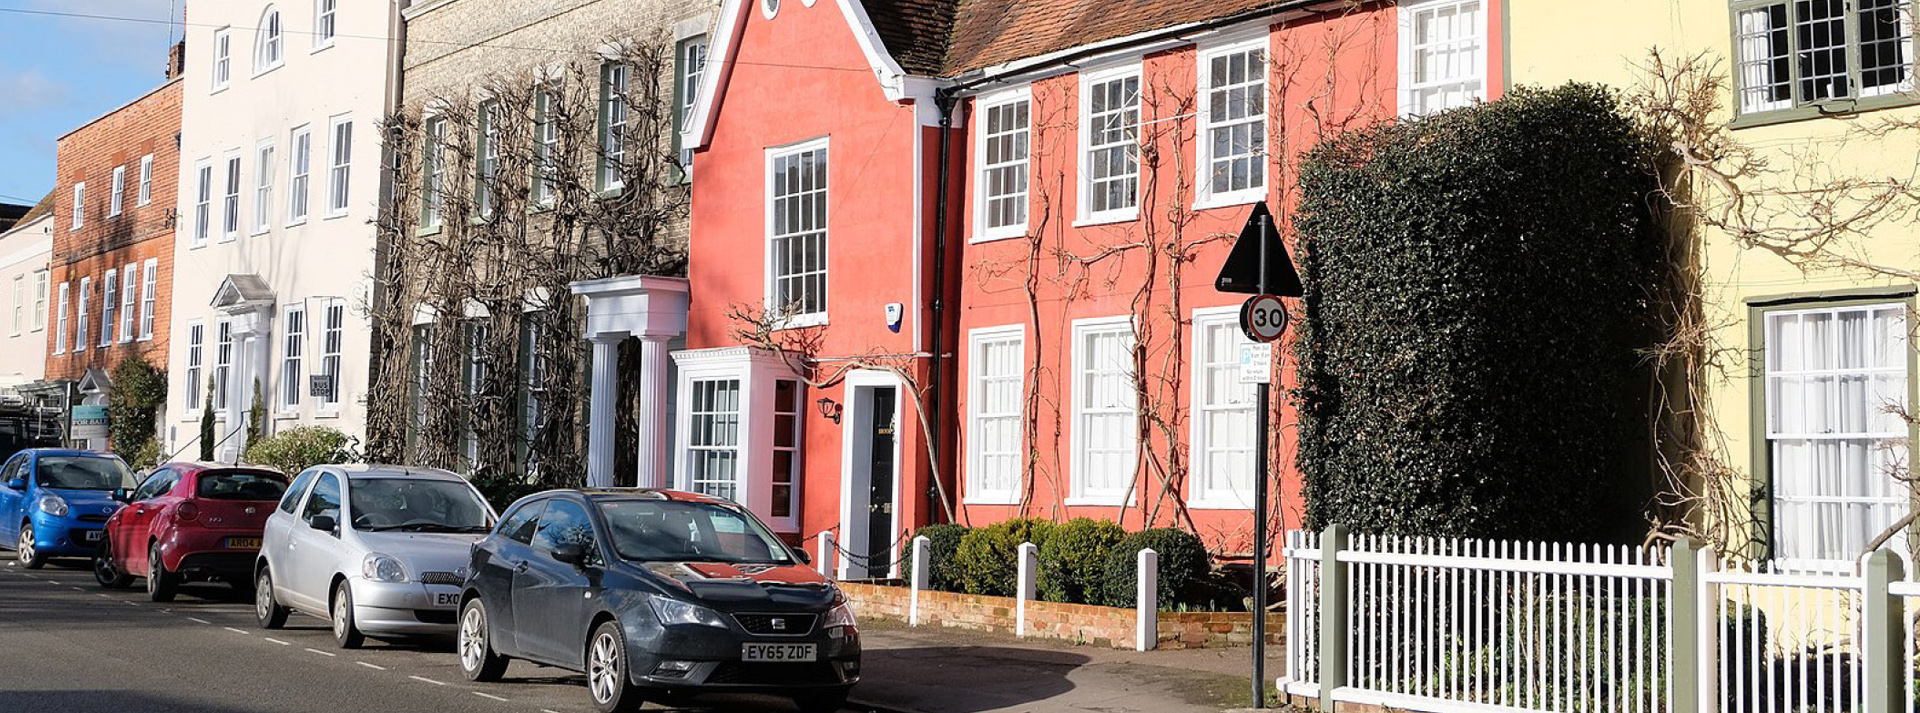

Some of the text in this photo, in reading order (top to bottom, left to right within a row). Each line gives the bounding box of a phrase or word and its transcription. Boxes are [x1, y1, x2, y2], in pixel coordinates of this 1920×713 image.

[1254, 307, 1283, 328] 30
[231, 538, 254, 547] AR04
[747, 645, 812, 659] EY65 ZDF
